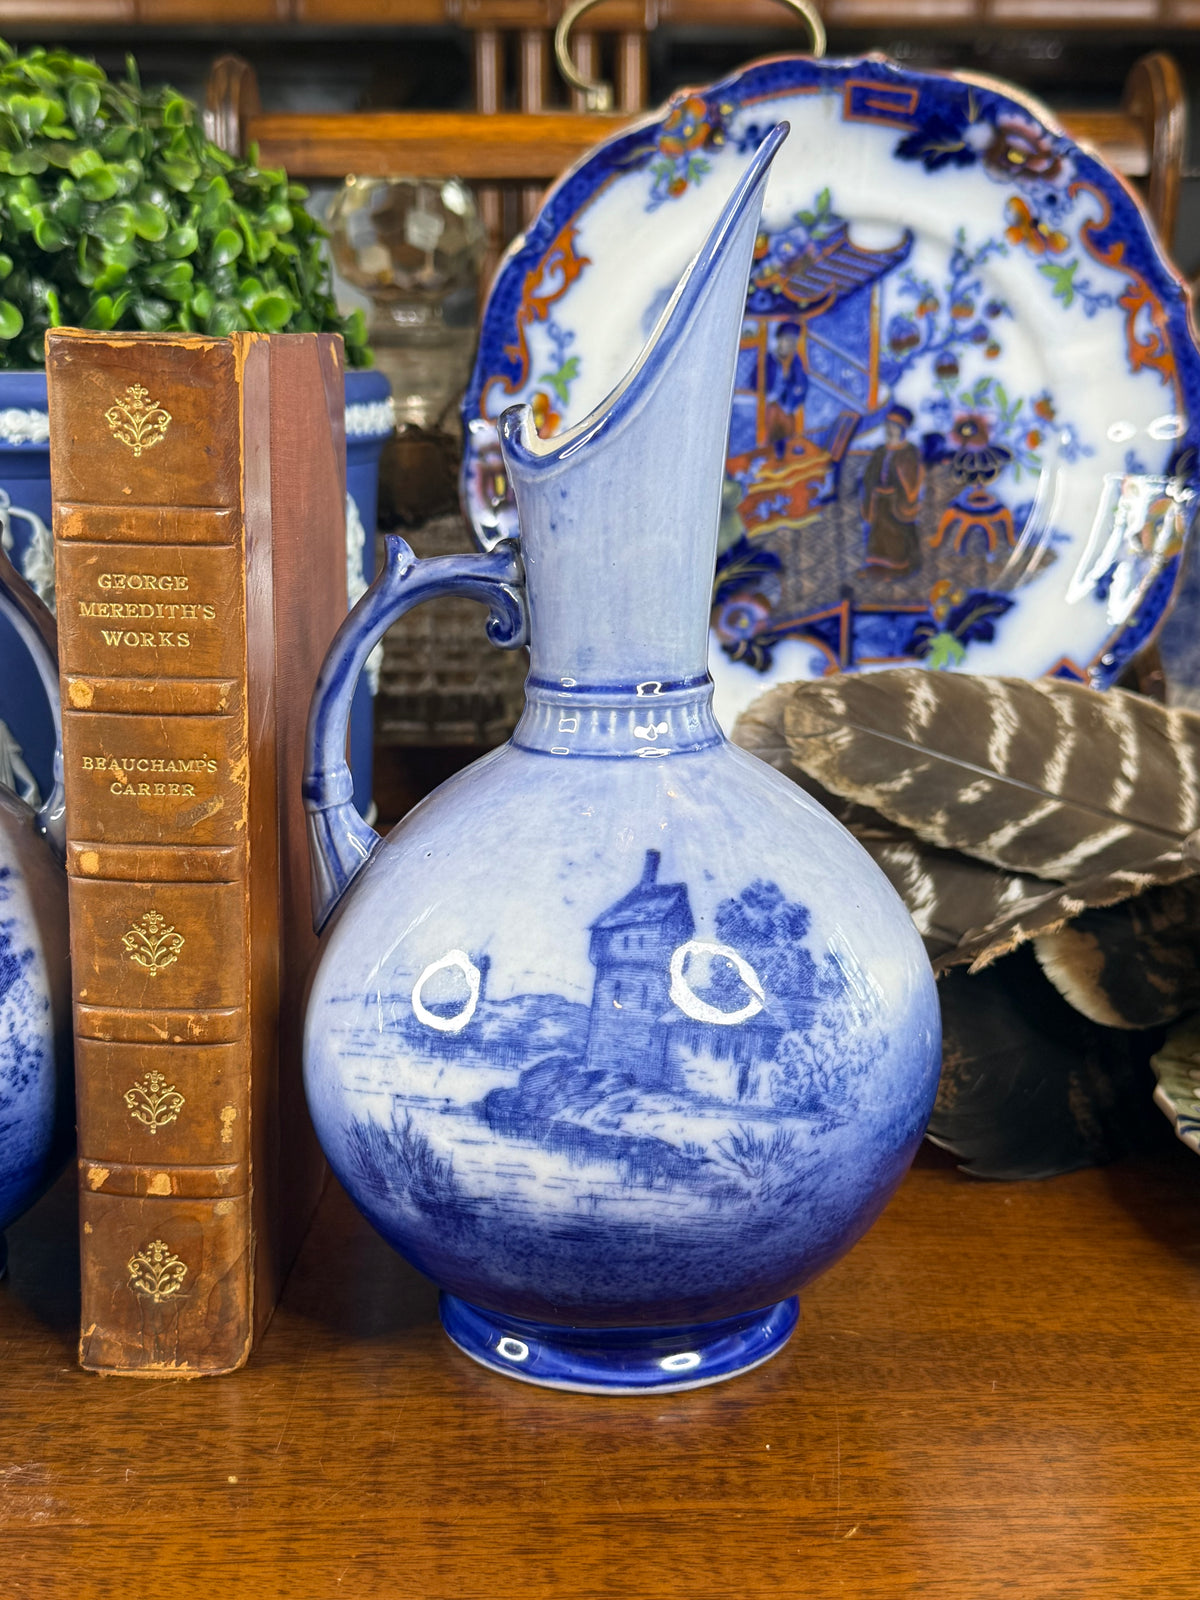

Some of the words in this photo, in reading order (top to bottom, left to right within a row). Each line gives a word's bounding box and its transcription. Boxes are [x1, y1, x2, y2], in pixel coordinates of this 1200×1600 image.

[98, 573, 189, 591] GEORGE
[78, 601, 216, 620] MEREDITH'S
[101, 630, 191, 648] WORKS
[82, 755, 218, 773] BEAUCHAMP'S
[110, 782, 196, 797] CAREER
